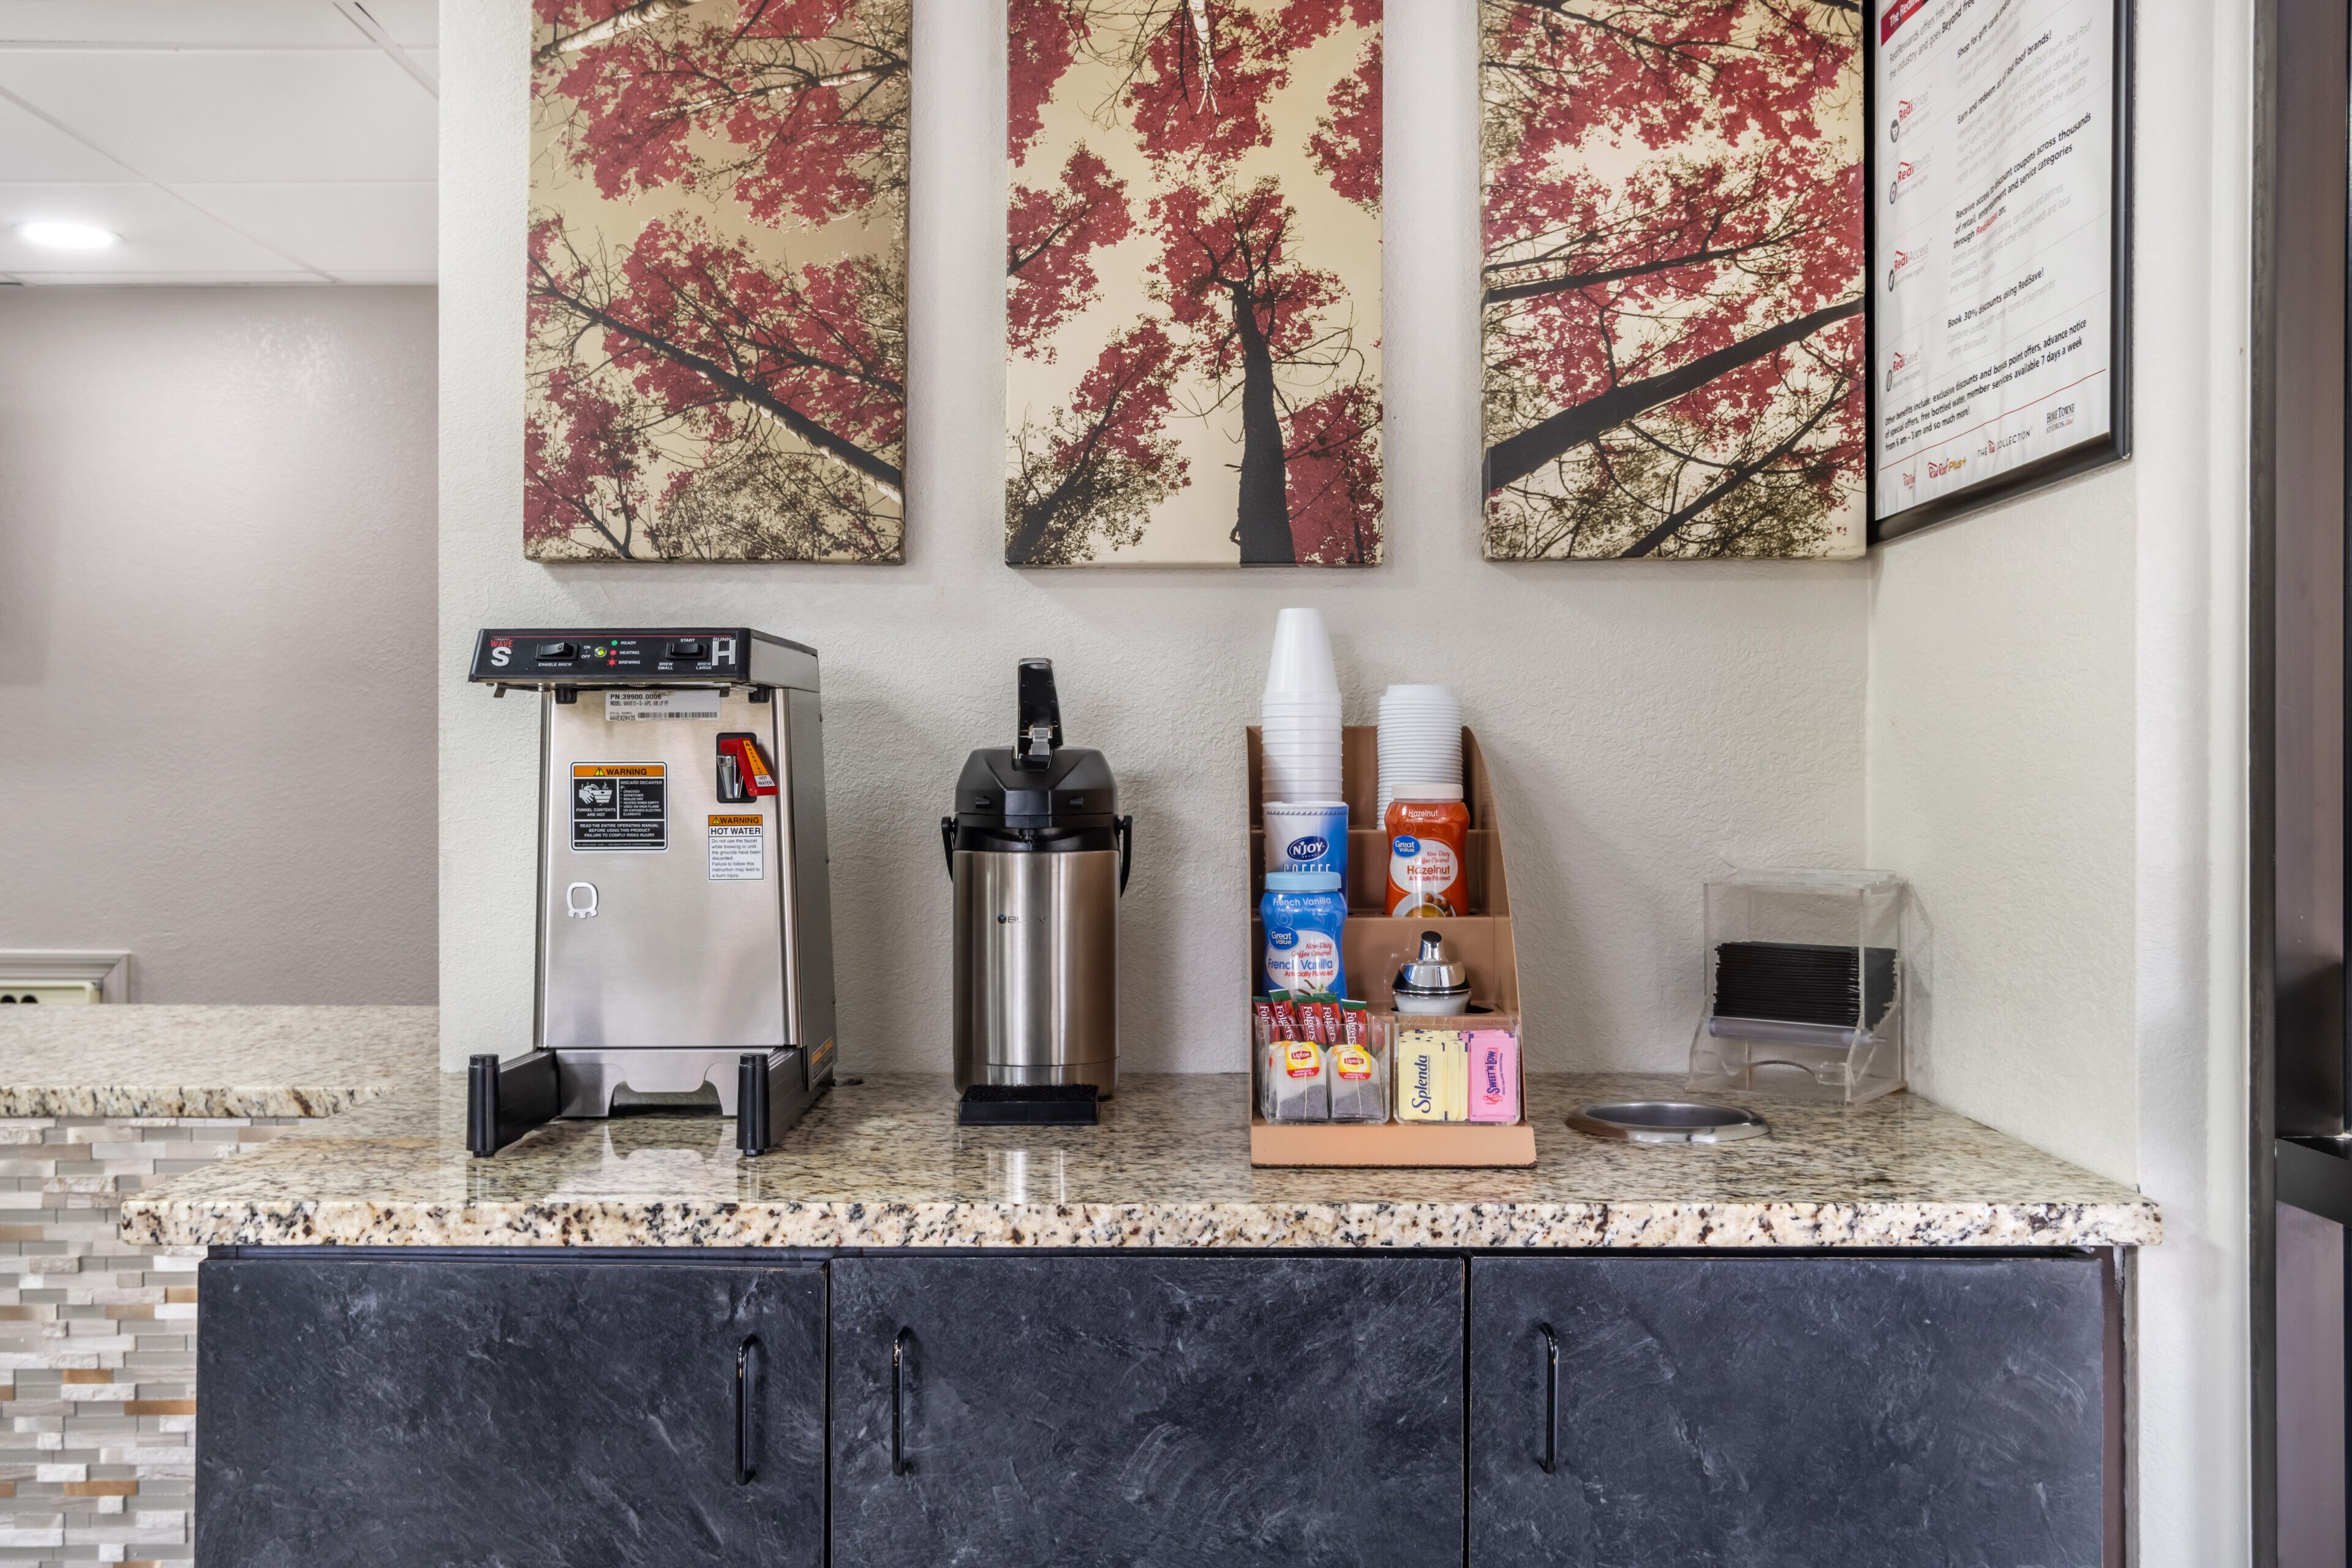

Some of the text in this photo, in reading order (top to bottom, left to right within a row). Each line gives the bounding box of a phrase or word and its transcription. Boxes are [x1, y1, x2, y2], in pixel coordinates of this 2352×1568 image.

[1890, 12, 1899, 28] The
[1920, 18, 1934, 36] offers
[1898, 51, 1917, 70] industry
[1942, 6, 1962, 34] Beyond
[1958, 43, 1970, 59] Shop
[1958, 30, 2052, 125] Earn and redeem Roof brands!
[1956, 111, 2092, 221] Receive access discount coupons across thousands
[1961, 143, 2073, 230] retail, entertainment and service categories
[1953, 211, 1998, 249] through RediAccess
[1894, 244, 1929, 272] RediAccess
[1947, 266, 2045, 329] Book 30% discounts using RediSave!
[1885, 318, 2087, 426] Other benefits include: exclusive discounts and bonus point offers, advance notice
[1890, 336, 2082, 438] special offers, free bottled water, member services available 7 days week
[1885, 405, 1970, 452] from and so much more!
[1977, 429, 2030, 458] THE COLLECTION
[491, 639, 513, 647] WAVE
[491, 647, 512, 666] S
[712, 639, 736, 666] H
[1407, 865, 1450, 875] Hazelnut
[1273, 897, 1332, 907] French Vanilla
[1271, 931, 1292, 940] Great
[1276, 1005, 1294, 1040] Folgers
[1303, 1006, 1317, 1041] Folgers
[1322, 1006, 1337, 1042] Folgers
[1346, 1012, 1357, 1046] Folgers
[1411, 1054, 1431, 1114] Splenda
[1485, 1051, 1500, 1094] SWEET'N LOW
